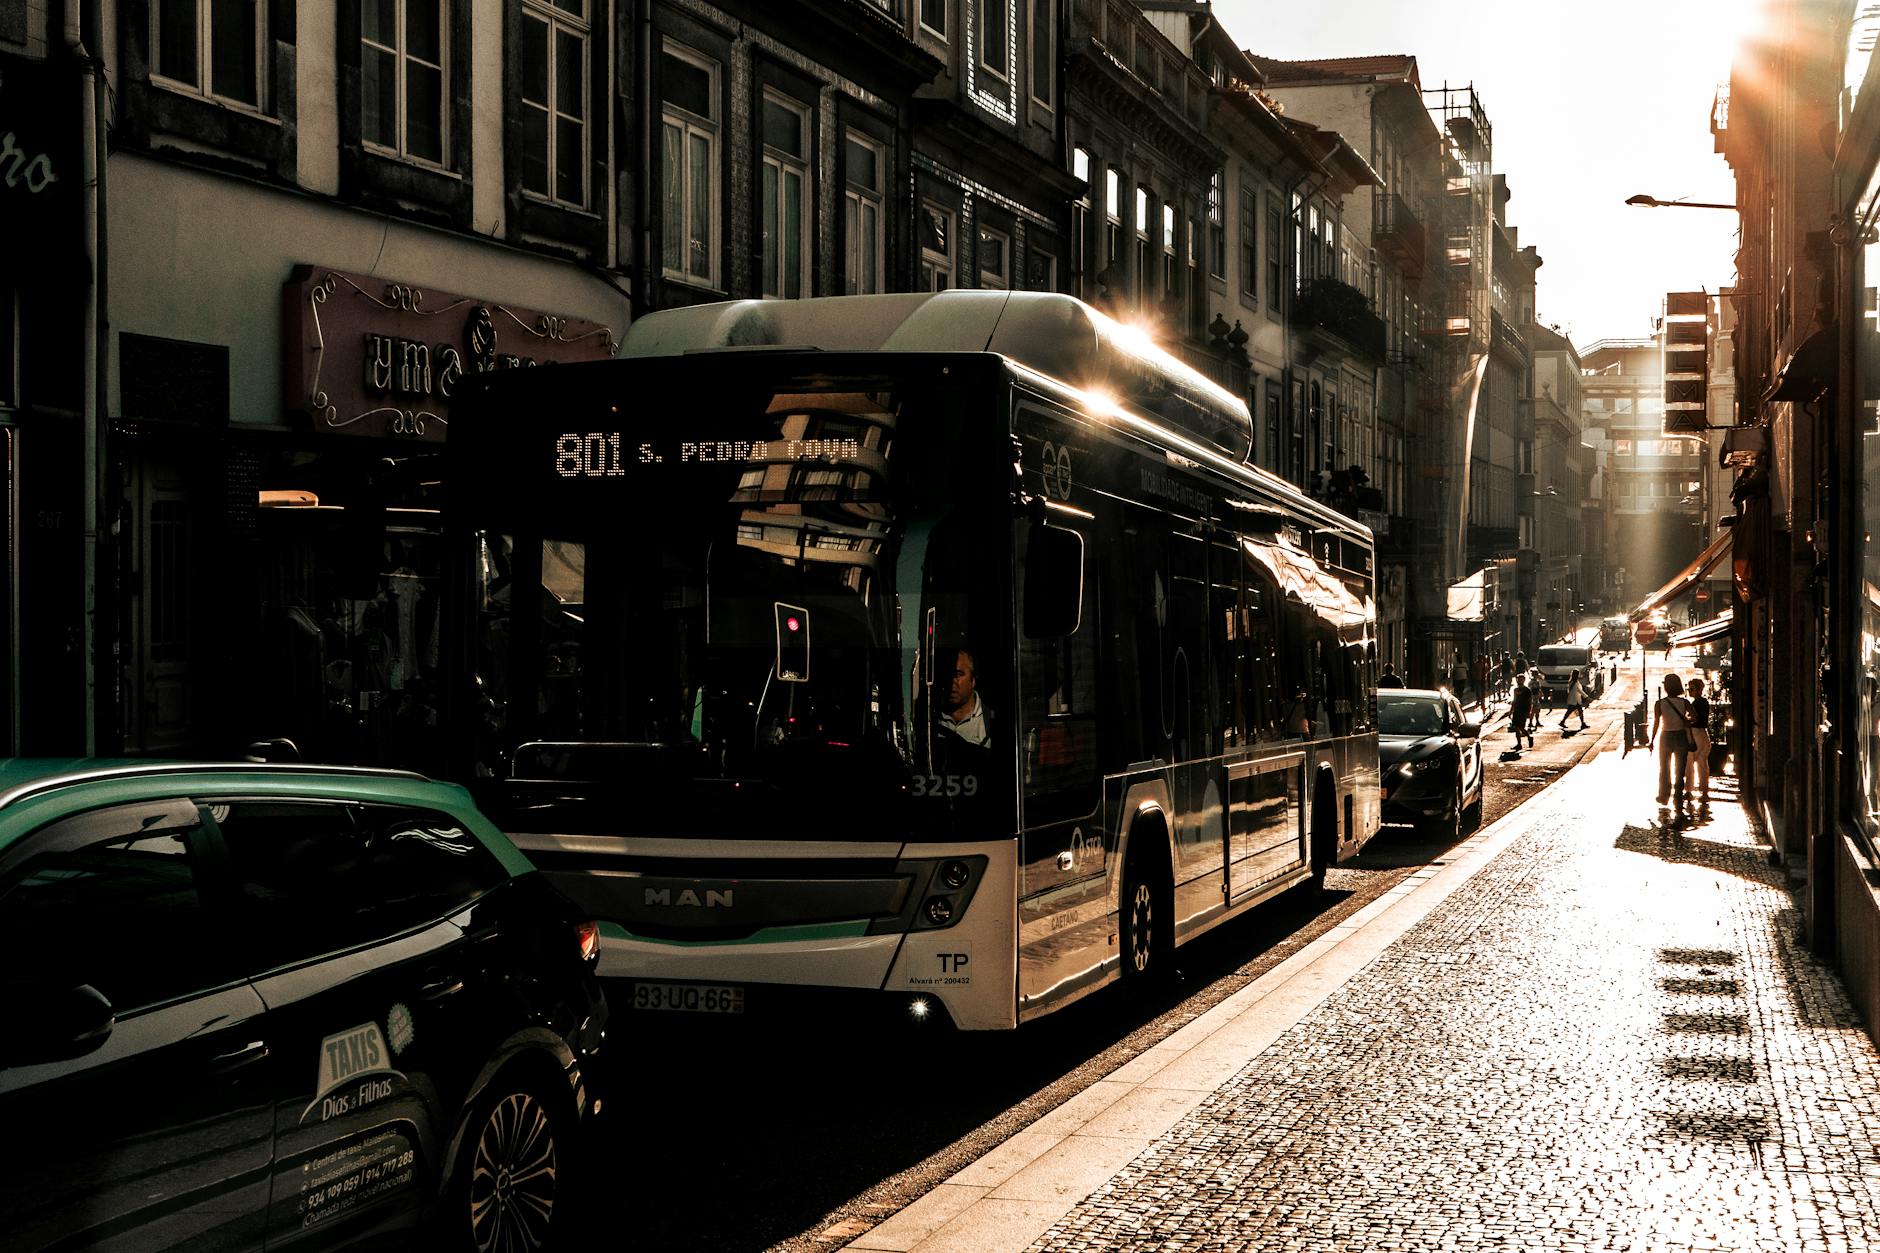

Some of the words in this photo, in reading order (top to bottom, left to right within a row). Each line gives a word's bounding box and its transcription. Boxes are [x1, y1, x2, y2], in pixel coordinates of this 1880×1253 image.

[0, 131, 60, 194] ro
[555, 431, 626, 477] 801
[638, 442, 663, 463] S.
[681, 440, 768, 463] PEDRO
[787, 437, 858, 461] COVA
[911, 774, 978, 797] 3259
[643, 886, 735, 908] MAN
[1052, 909, 1079, 931] CAETANO
[936, 953, 969, 973] TP
[325, 1028, 380, 1081] TAXIS
[322, 1095, 349, 1121] Dias
[358, 1078, 393, 1107] Filhas
[312, 1153, 337, 1171] Central
[308, 1190, 326, 1209] 934
[327, 1183, 342, 1200] 109
[343, 1174, 360, 1192] 059
[366, 1164, 382, 1184] 914
[382, 1157, 397, 1176] 717
[398, 1149, 414, 1168] 288
